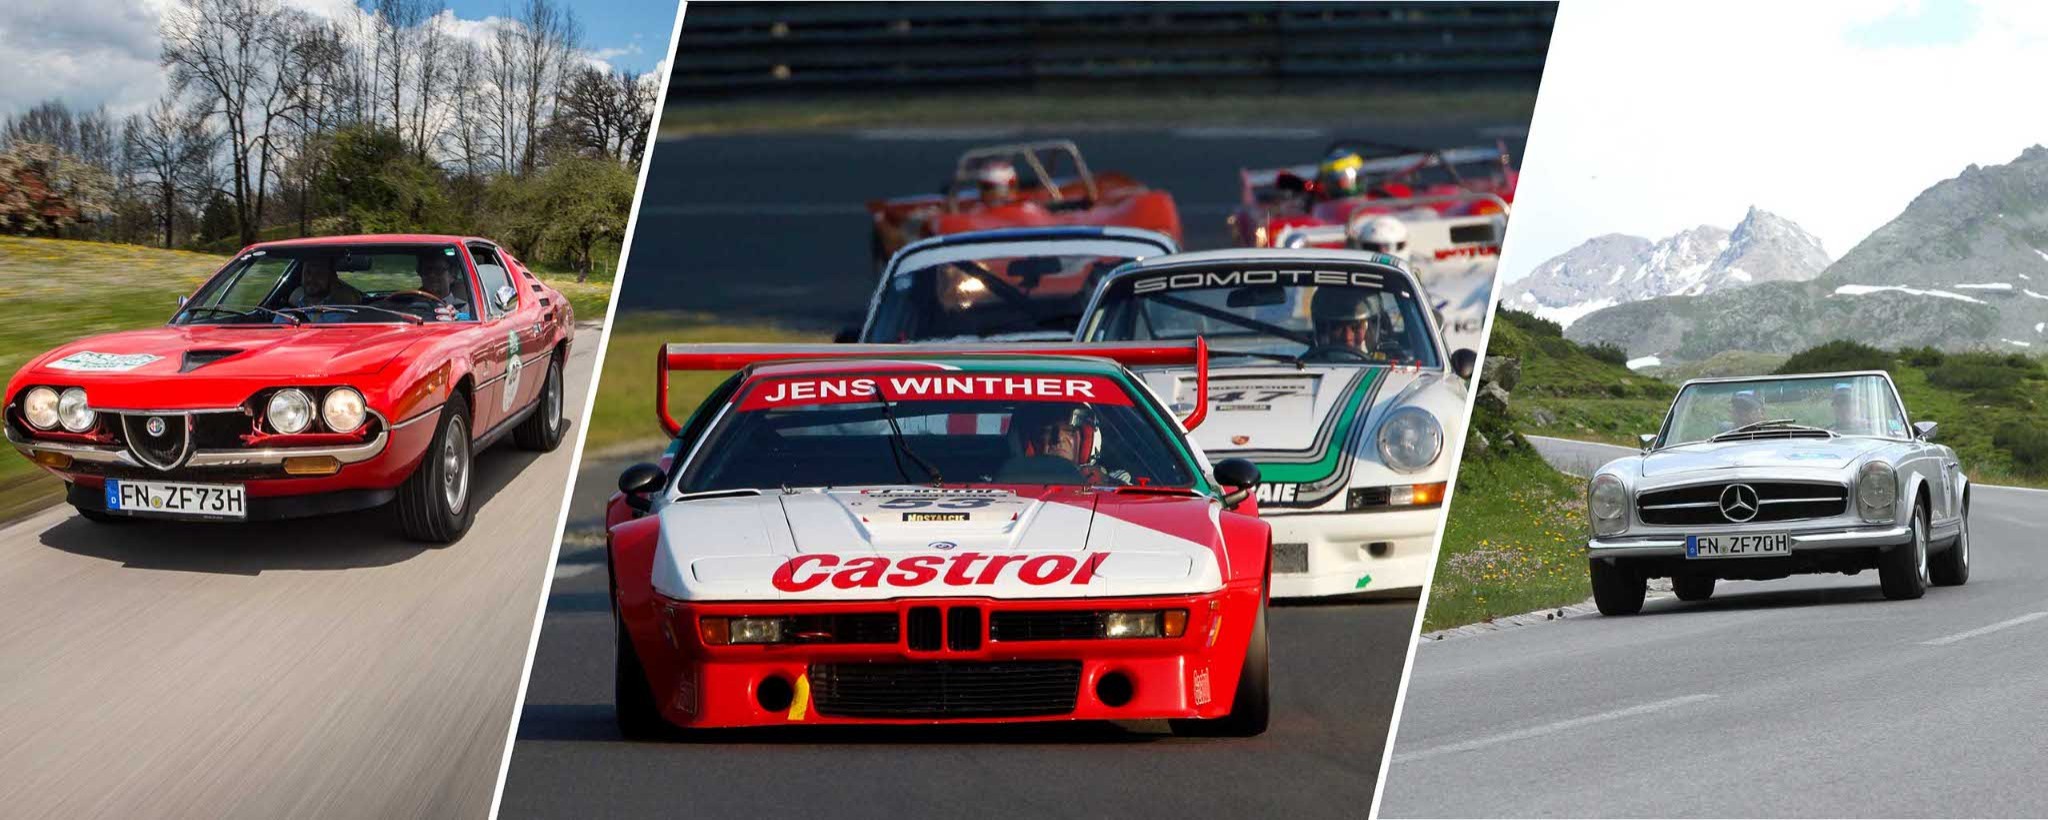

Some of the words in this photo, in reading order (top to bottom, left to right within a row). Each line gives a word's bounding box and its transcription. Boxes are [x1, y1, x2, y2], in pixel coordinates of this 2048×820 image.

[1134, 270, 1384, 294] SOMOTEC
[765, 378, 876, 402] JENS
[890, 377, 1096, 398] WINTHER
[1207, 391, 1297, 403] 47
[120, 484, 150, 507] FN
[164, 486, 242, 512] ZF73H
[878, 498, 996, 509] 53
[1252, 483, 1297, 502] AIE
[1697, 537, 1719, 555] FN
[1729, 534, 1787, 553] ZF70H
[771, 552, 1111, 593] Castrol
